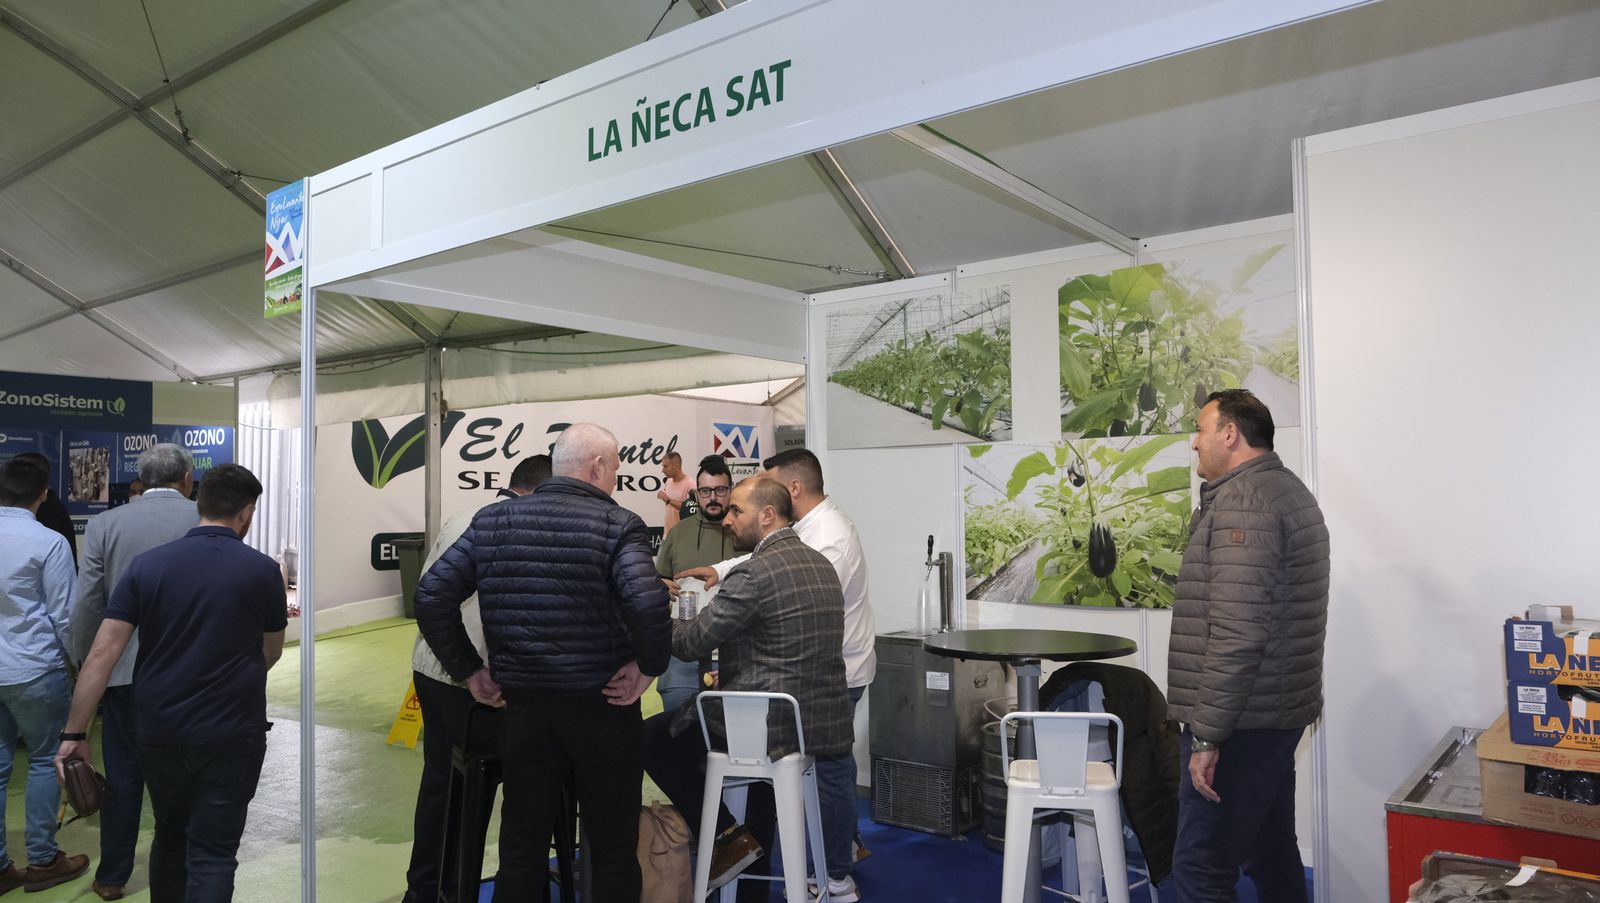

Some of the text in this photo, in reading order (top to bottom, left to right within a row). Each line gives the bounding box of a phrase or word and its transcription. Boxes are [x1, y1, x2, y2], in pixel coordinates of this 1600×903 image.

[588, 59, 791, 162] LA ÑECA SAT
[124, 434, 158, 451] OZONO
[184, 428, 225, 446] OZONO
[460, 417, 524, 462] El
[124, 461, 139, 472] RIEG
[1529, 652, 1561, 671] LA
[1533, 715, 1565, 734] LA
